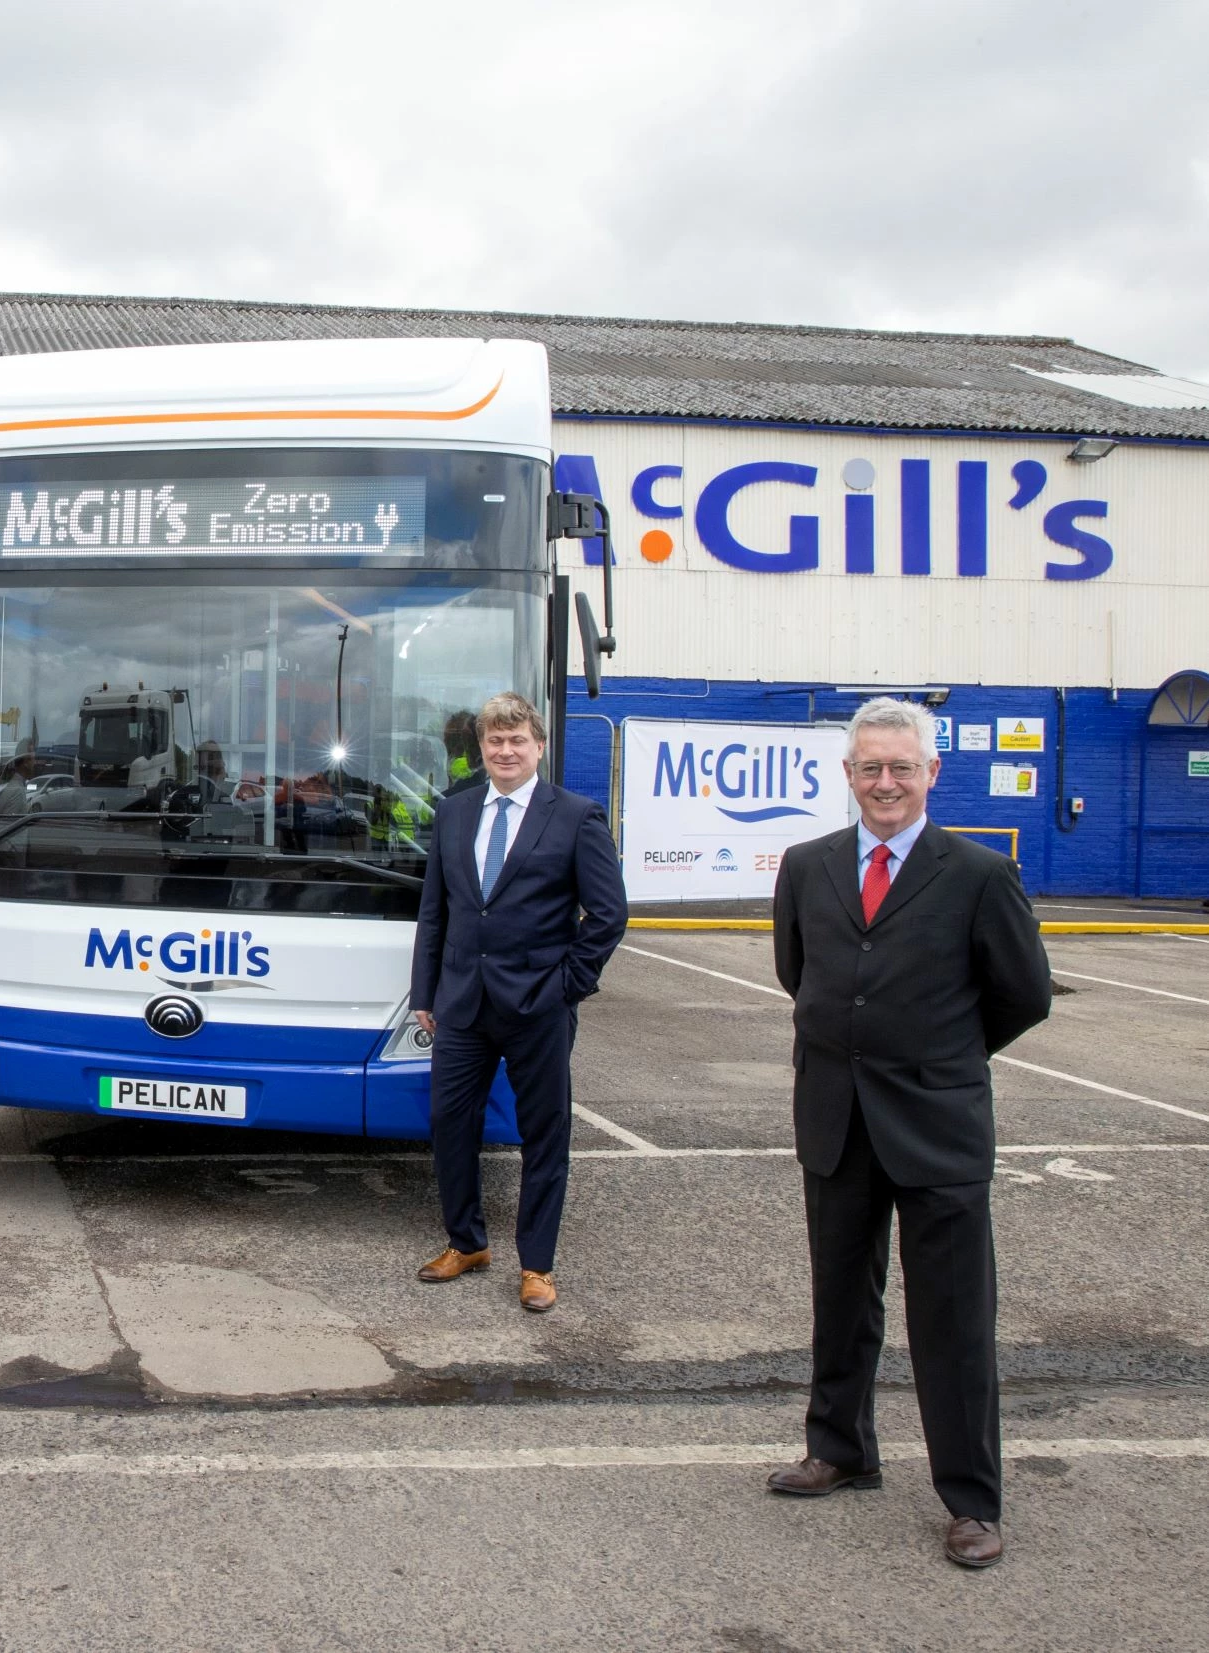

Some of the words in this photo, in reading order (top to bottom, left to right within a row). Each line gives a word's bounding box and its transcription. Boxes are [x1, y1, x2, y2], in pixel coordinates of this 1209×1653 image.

[244, 484, 331, 513] Zero
[2, 485, 188, 546] McGill's
[208, 513, 365, 544] Emission
[652, 741, 820, 800] McGill's
[644, 851, 694, 863] PELICAN
[644, 864, 675, 873] Engineering
[676, 864, 693, 872] Group
[755, 854, 784, 871] ZE
[84, 927, 271, 978] McGill's
[118, 1081, 227, 1112] PELICAN
